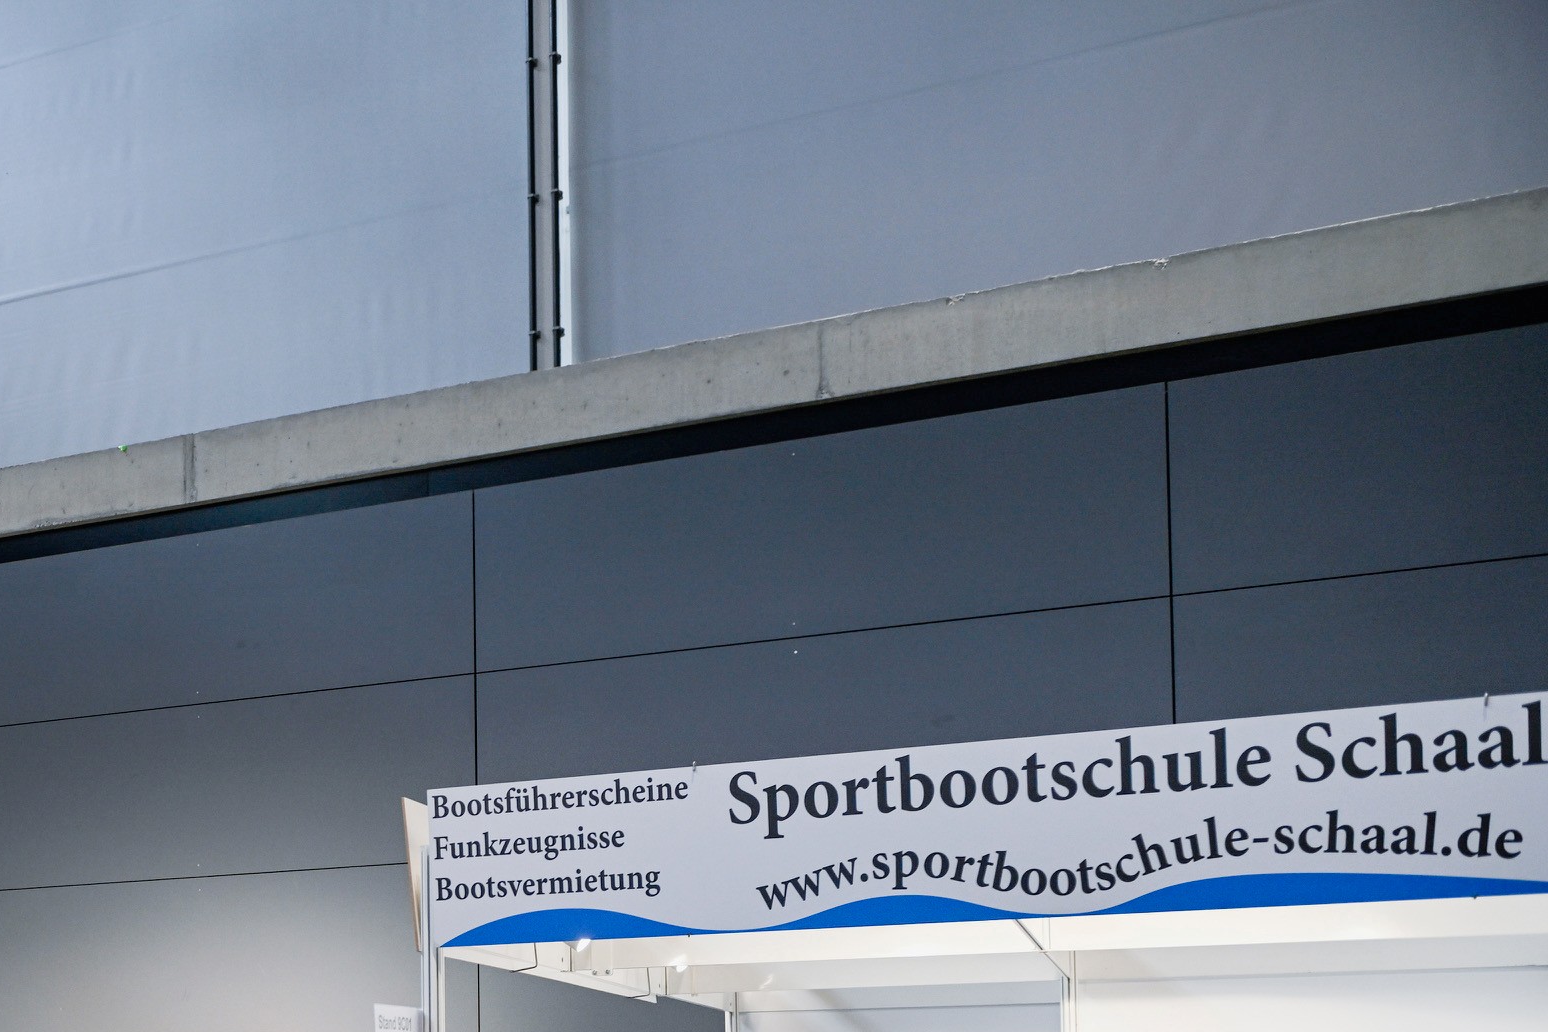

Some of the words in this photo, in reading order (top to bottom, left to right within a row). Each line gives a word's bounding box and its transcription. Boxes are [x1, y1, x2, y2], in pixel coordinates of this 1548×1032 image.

[729, 727, 1272, 840] Sportbootschule
[1295, 699, 1548, 783] Schaal
[432, 777, 689, 819] Bootsführerscheine
[434, 826, 625, 861] Funkzeugnisse
[756, 809, 1523, 911] www.sportbootschule-schaal.de
[436, 868, 661, 901] Bootsvermietung
[378, 1014, 396, 1030] Stand
